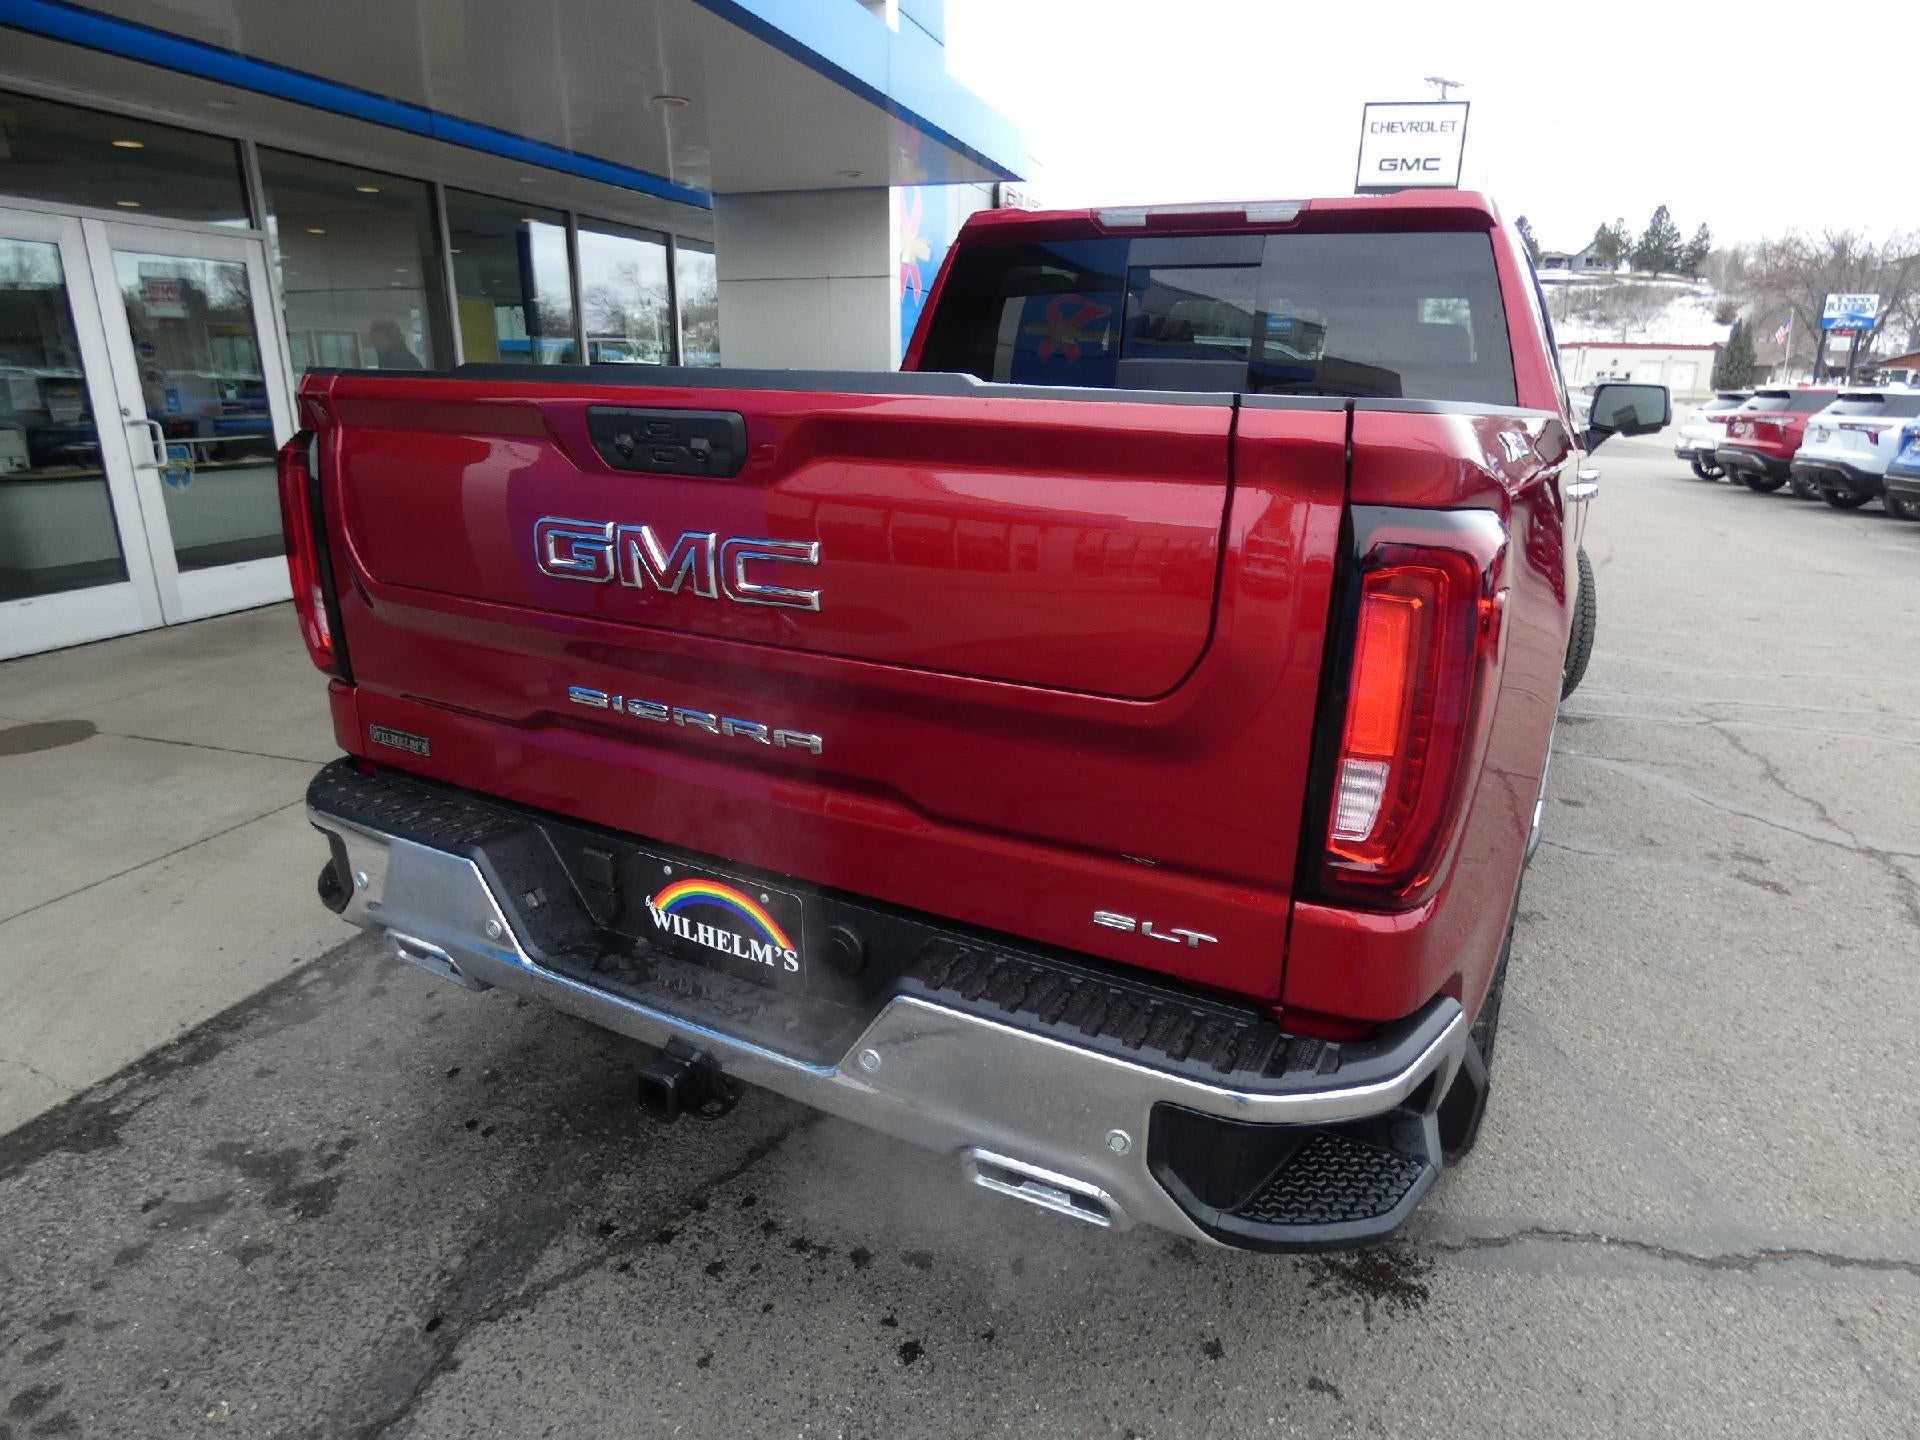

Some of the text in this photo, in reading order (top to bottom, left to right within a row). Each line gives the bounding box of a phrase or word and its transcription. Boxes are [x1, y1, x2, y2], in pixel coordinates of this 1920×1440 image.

[1370, 120, 1458, 134] CHEVROLET
[1378, 157, 1442, 171] GMC
[533, 515, 822, 612] GMC
[568, 685, 823, 755] SIERRA
[650, 907, 800, 973] WILHELM'S
[1093, 910, 1219, 949] SLT
